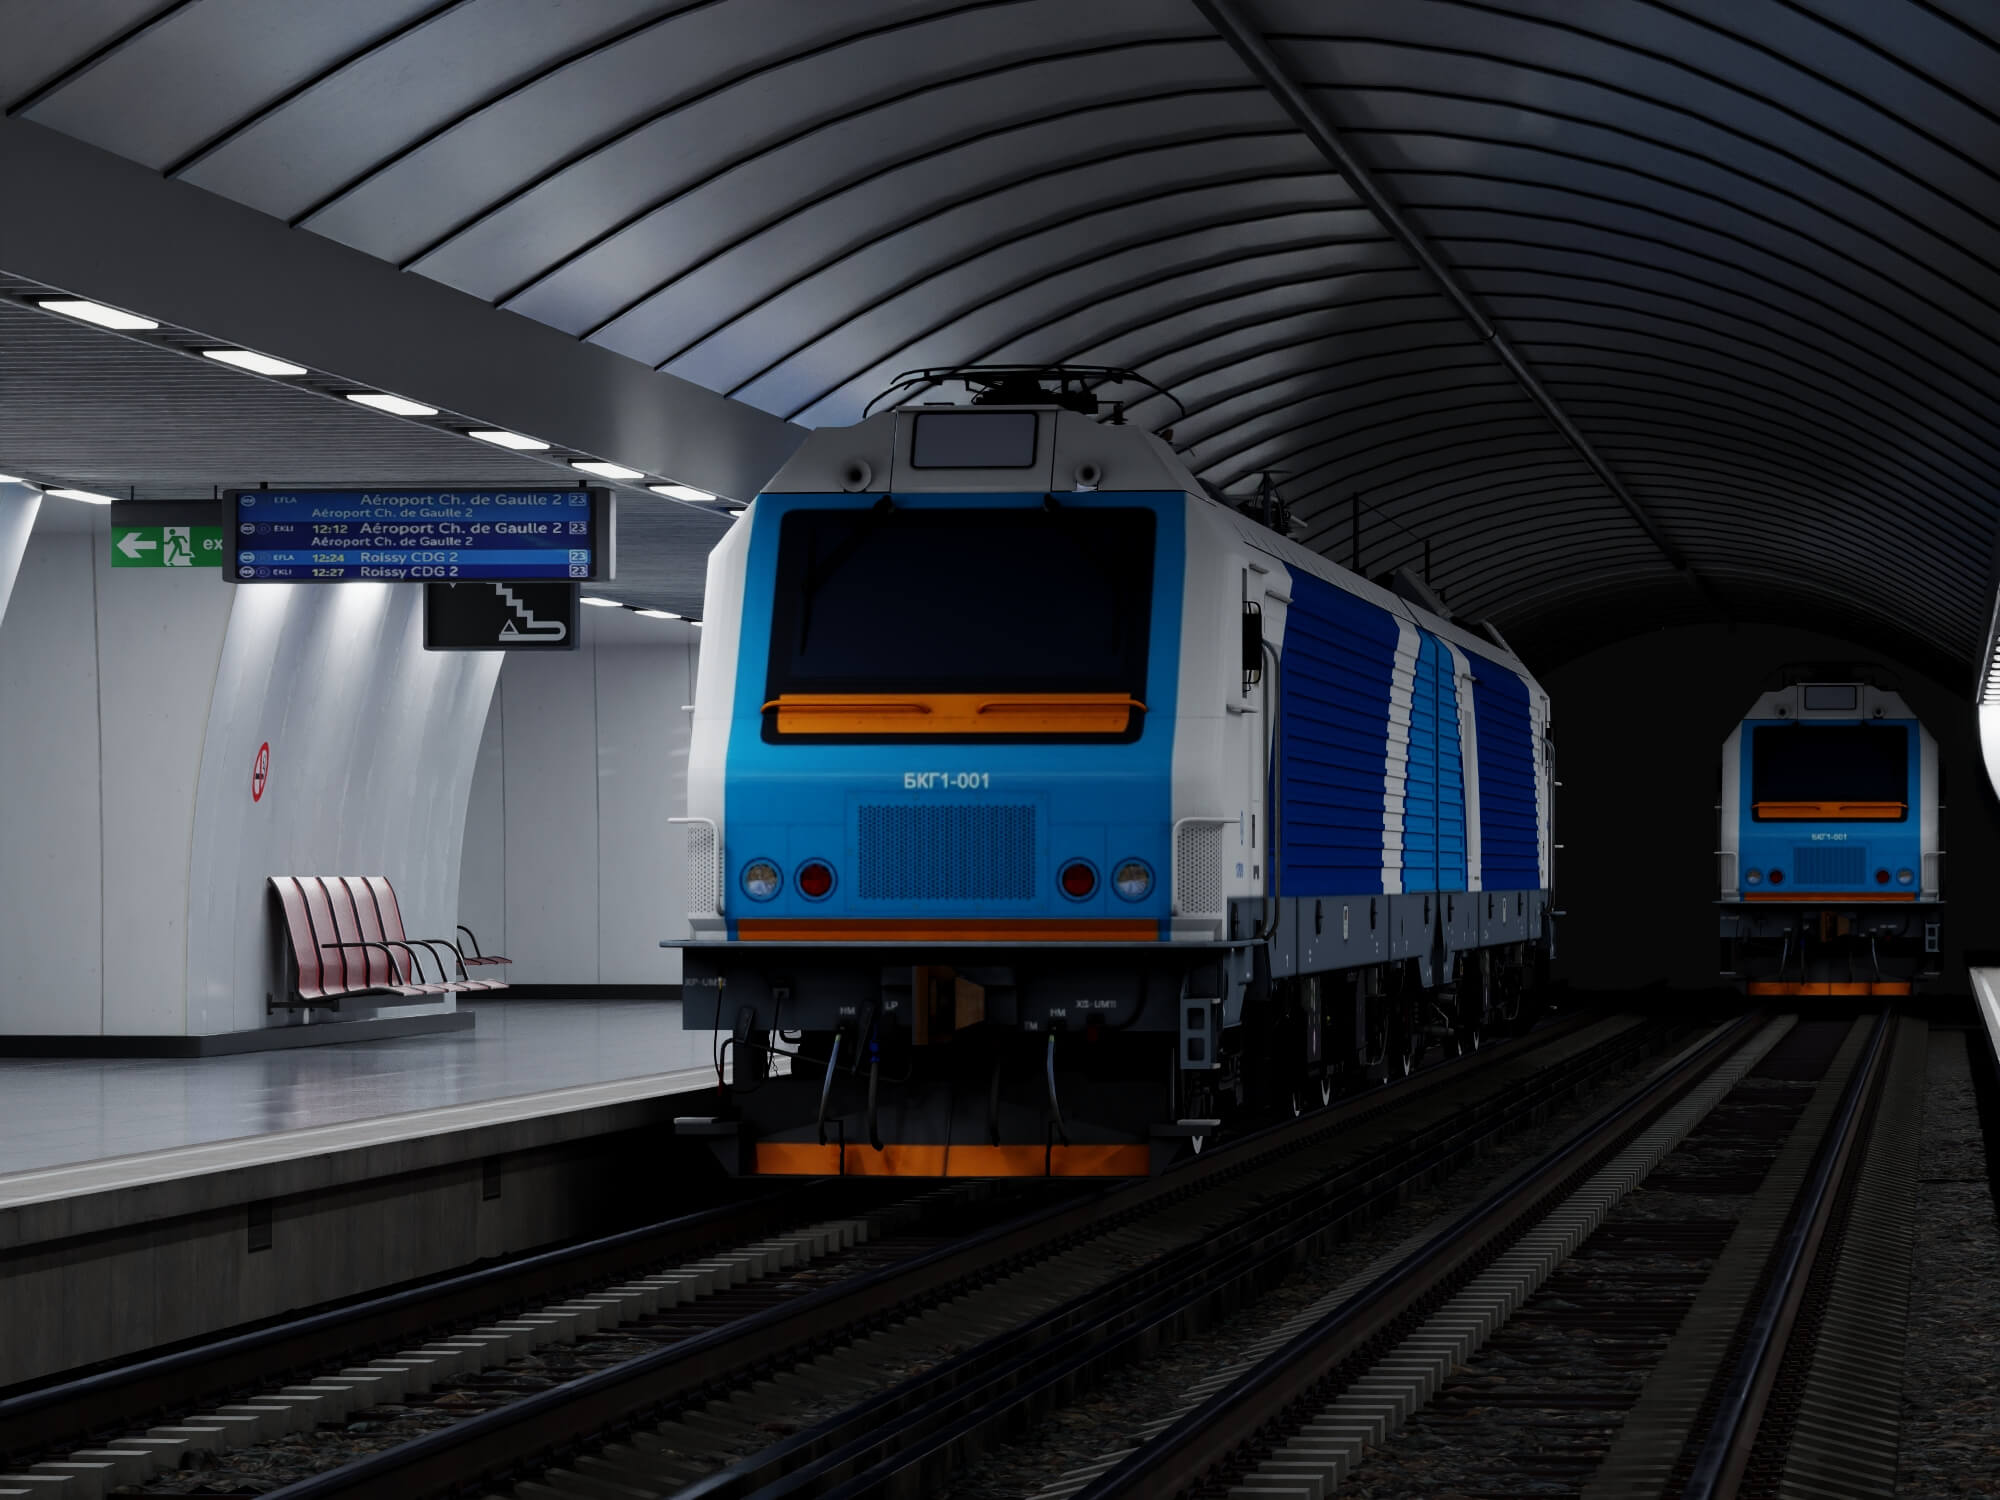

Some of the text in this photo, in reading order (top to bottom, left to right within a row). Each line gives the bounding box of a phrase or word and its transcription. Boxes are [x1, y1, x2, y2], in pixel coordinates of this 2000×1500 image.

[360, 493, 433, 507] Aéroport
[438, 494, 466, 505] Ch.
[470, 494, 491, 505] de
[495, 494, 548, 505] Gaulle
[552, 494, 562, 505] 2
[570, 495, 586, 504] 23
[311, 508, 473, 519] Aéroport Ch. de Gaulle 2
[312, 524, 348, 534] 12:12
[360, 522, 434, 535] Aéroport
[438, 522, 466, 534] Ch.
[470, 523, 491, 534] de
[495, 522, 548, 534] Gaulle
[552, 523, 562, 534] 2
[571, 523, 586, 533] 23
[203, 538, 223, 550] ex
[311, 536, 473, 548] Aéroport Ch. de Gaulle 2
[312, 553, 345, 562] 12:24
[360, 552, 407, 564] Roissy
[411, 552, 445, 562] CDG
[449, 552, 459, 562] 2
[571, 552, 586, 561] 23
[312, 568, 345, 577] 12:27
[360, 566, 407, 578] Roissy
[411, 566, 445, 577] CDG
[449, 566, 459, 577] 2
[571, 566, 587, 576] 23
[904, 772, 989, 789] БКГ1-001
